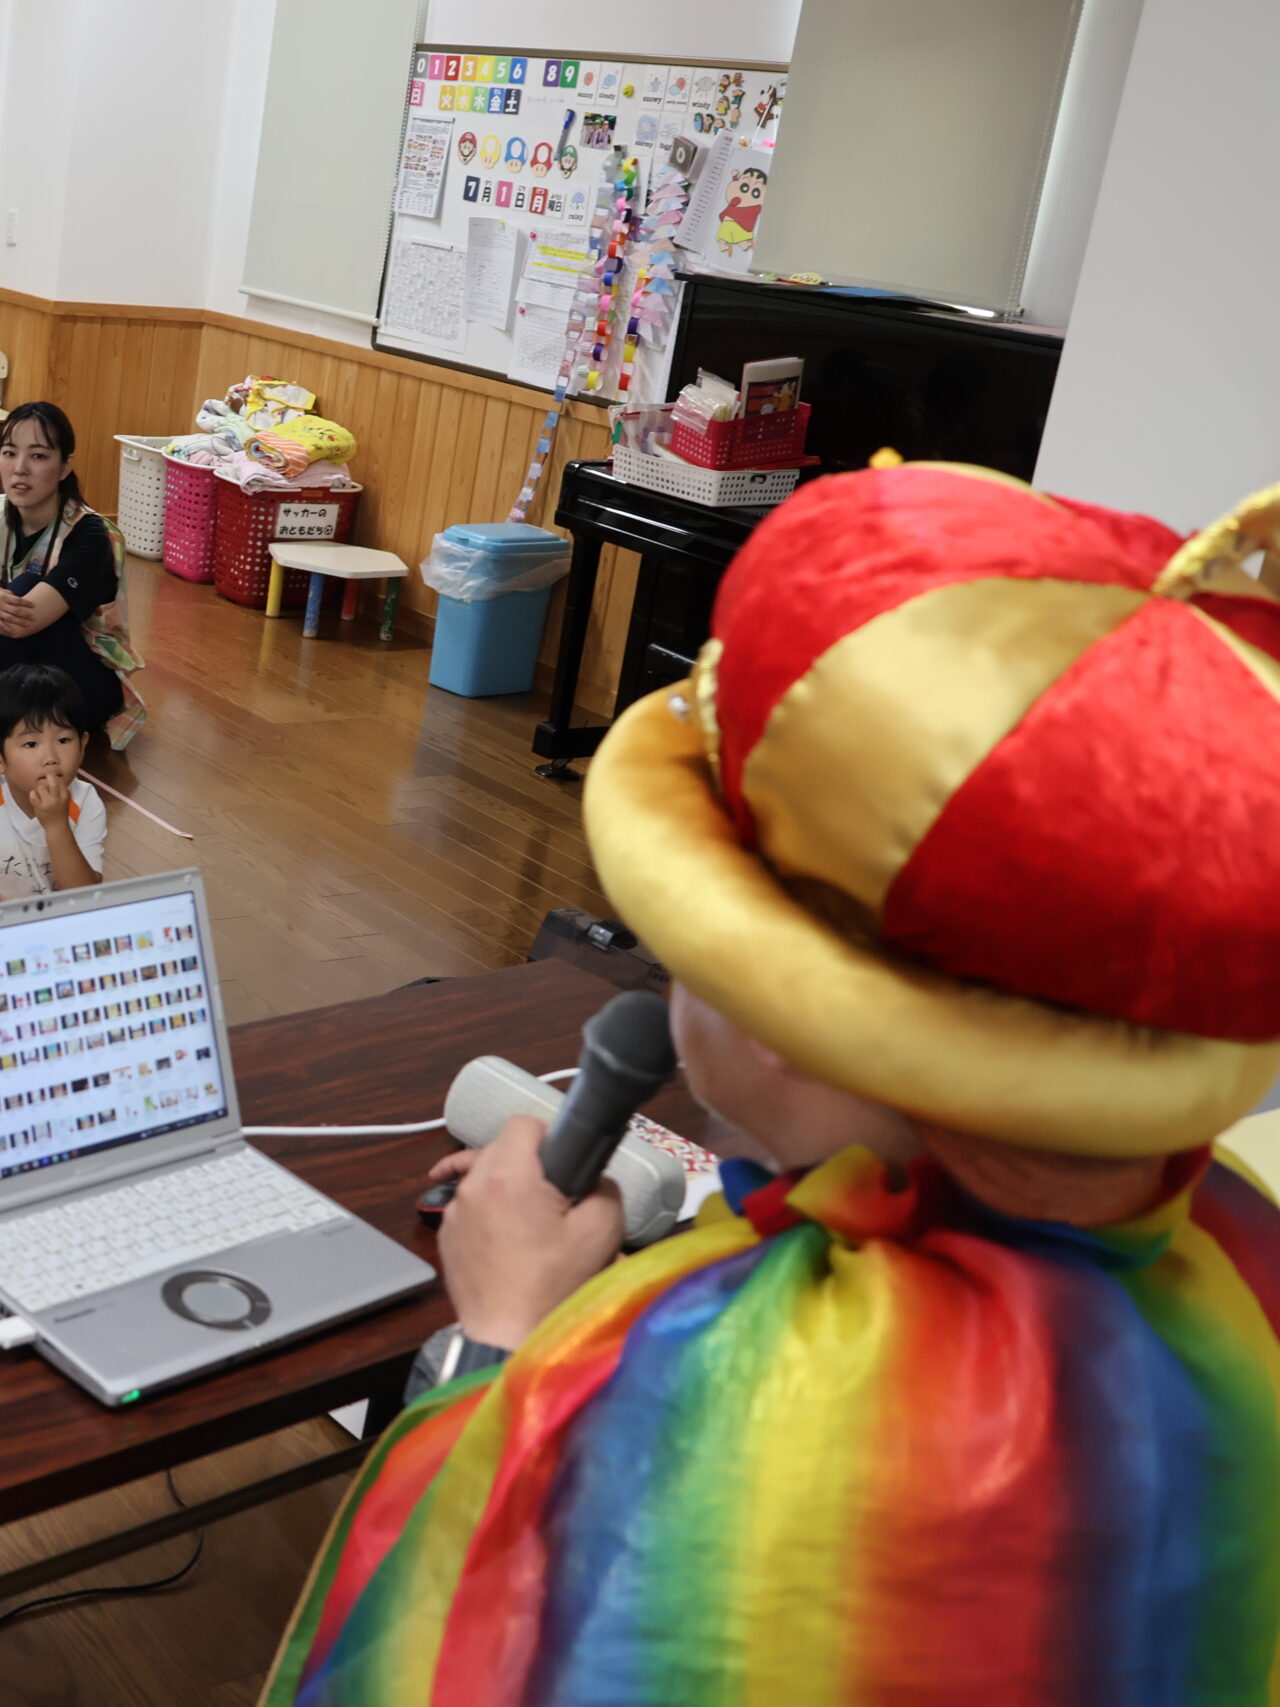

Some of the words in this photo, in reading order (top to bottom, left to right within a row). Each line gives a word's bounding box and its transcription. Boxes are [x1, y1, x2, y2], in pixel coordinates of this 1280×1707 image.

[417, 58, 426, 74] 0
[433, 60, 440, 75] 1
[447, 60, 457, 76] 2
[465, 61, 474, 76] 3
[481, 61, 490, 76] 4
[496, 62, 506, 78] 5
[513, 63, 522, 79] 6
[547, 65, 557, 81] 8
[565, 66, 575, 82] 9
[411, 89, 420, 104] 日
[441, 94, 452, 109] 火
[474, 94, 486, 110] 木
[489, 95, 503, 112] 金
[505, 96, 517, 112] 土
[283, 507, 327, 518] サッカーの
[279, 524, 323, 536] おともだち
